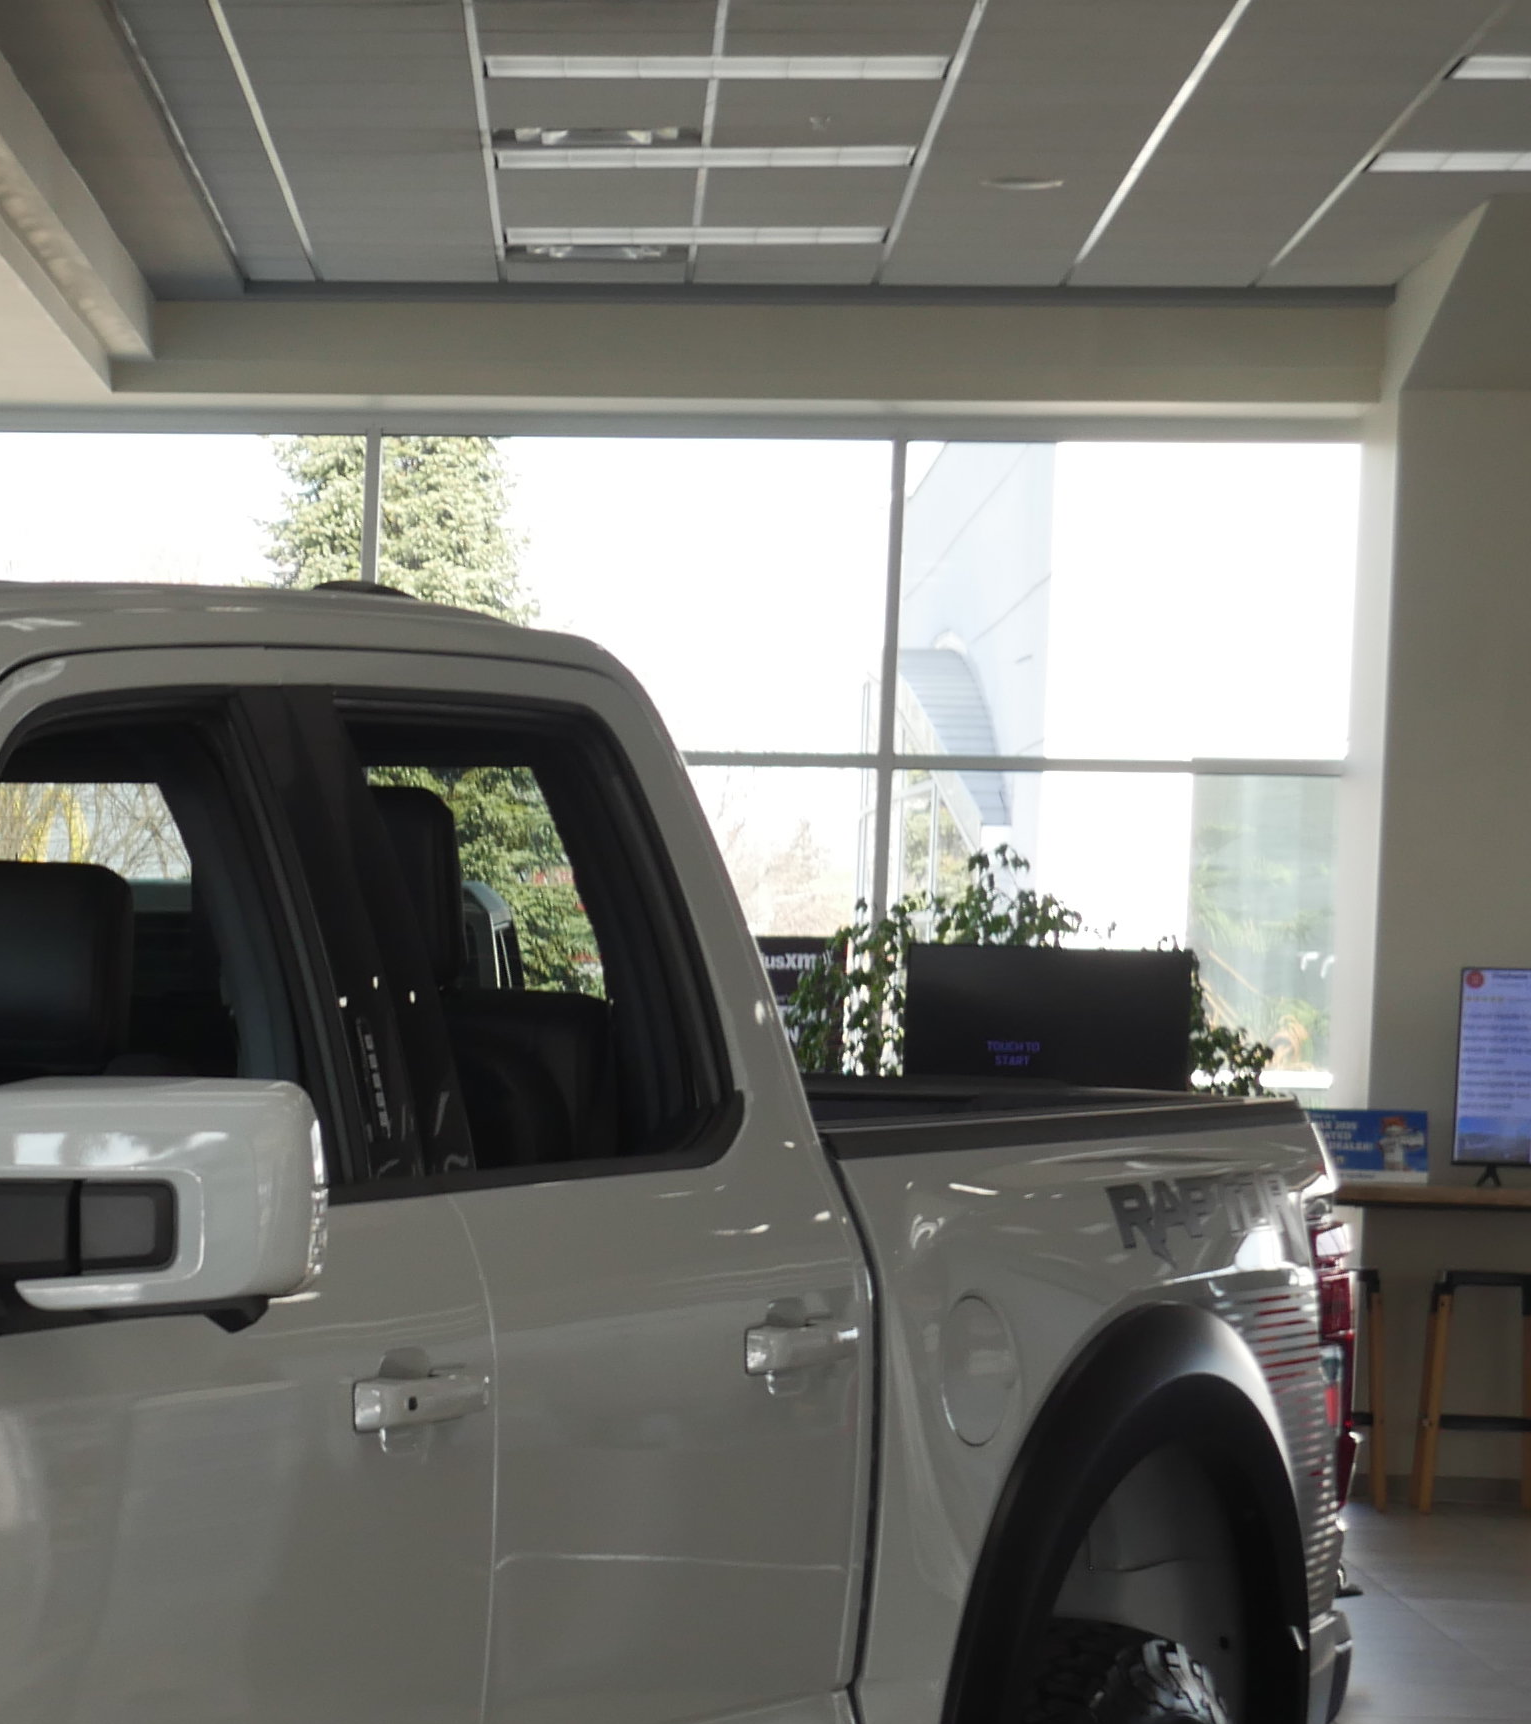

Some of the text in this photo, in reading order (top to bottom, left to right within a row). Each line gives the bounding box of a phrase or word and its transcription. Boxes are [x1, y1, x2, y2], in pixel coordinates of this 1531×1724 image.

[987, 1040, 1040, 1053] TOUCH TO
[995, 1055, 1030, 1067] START
